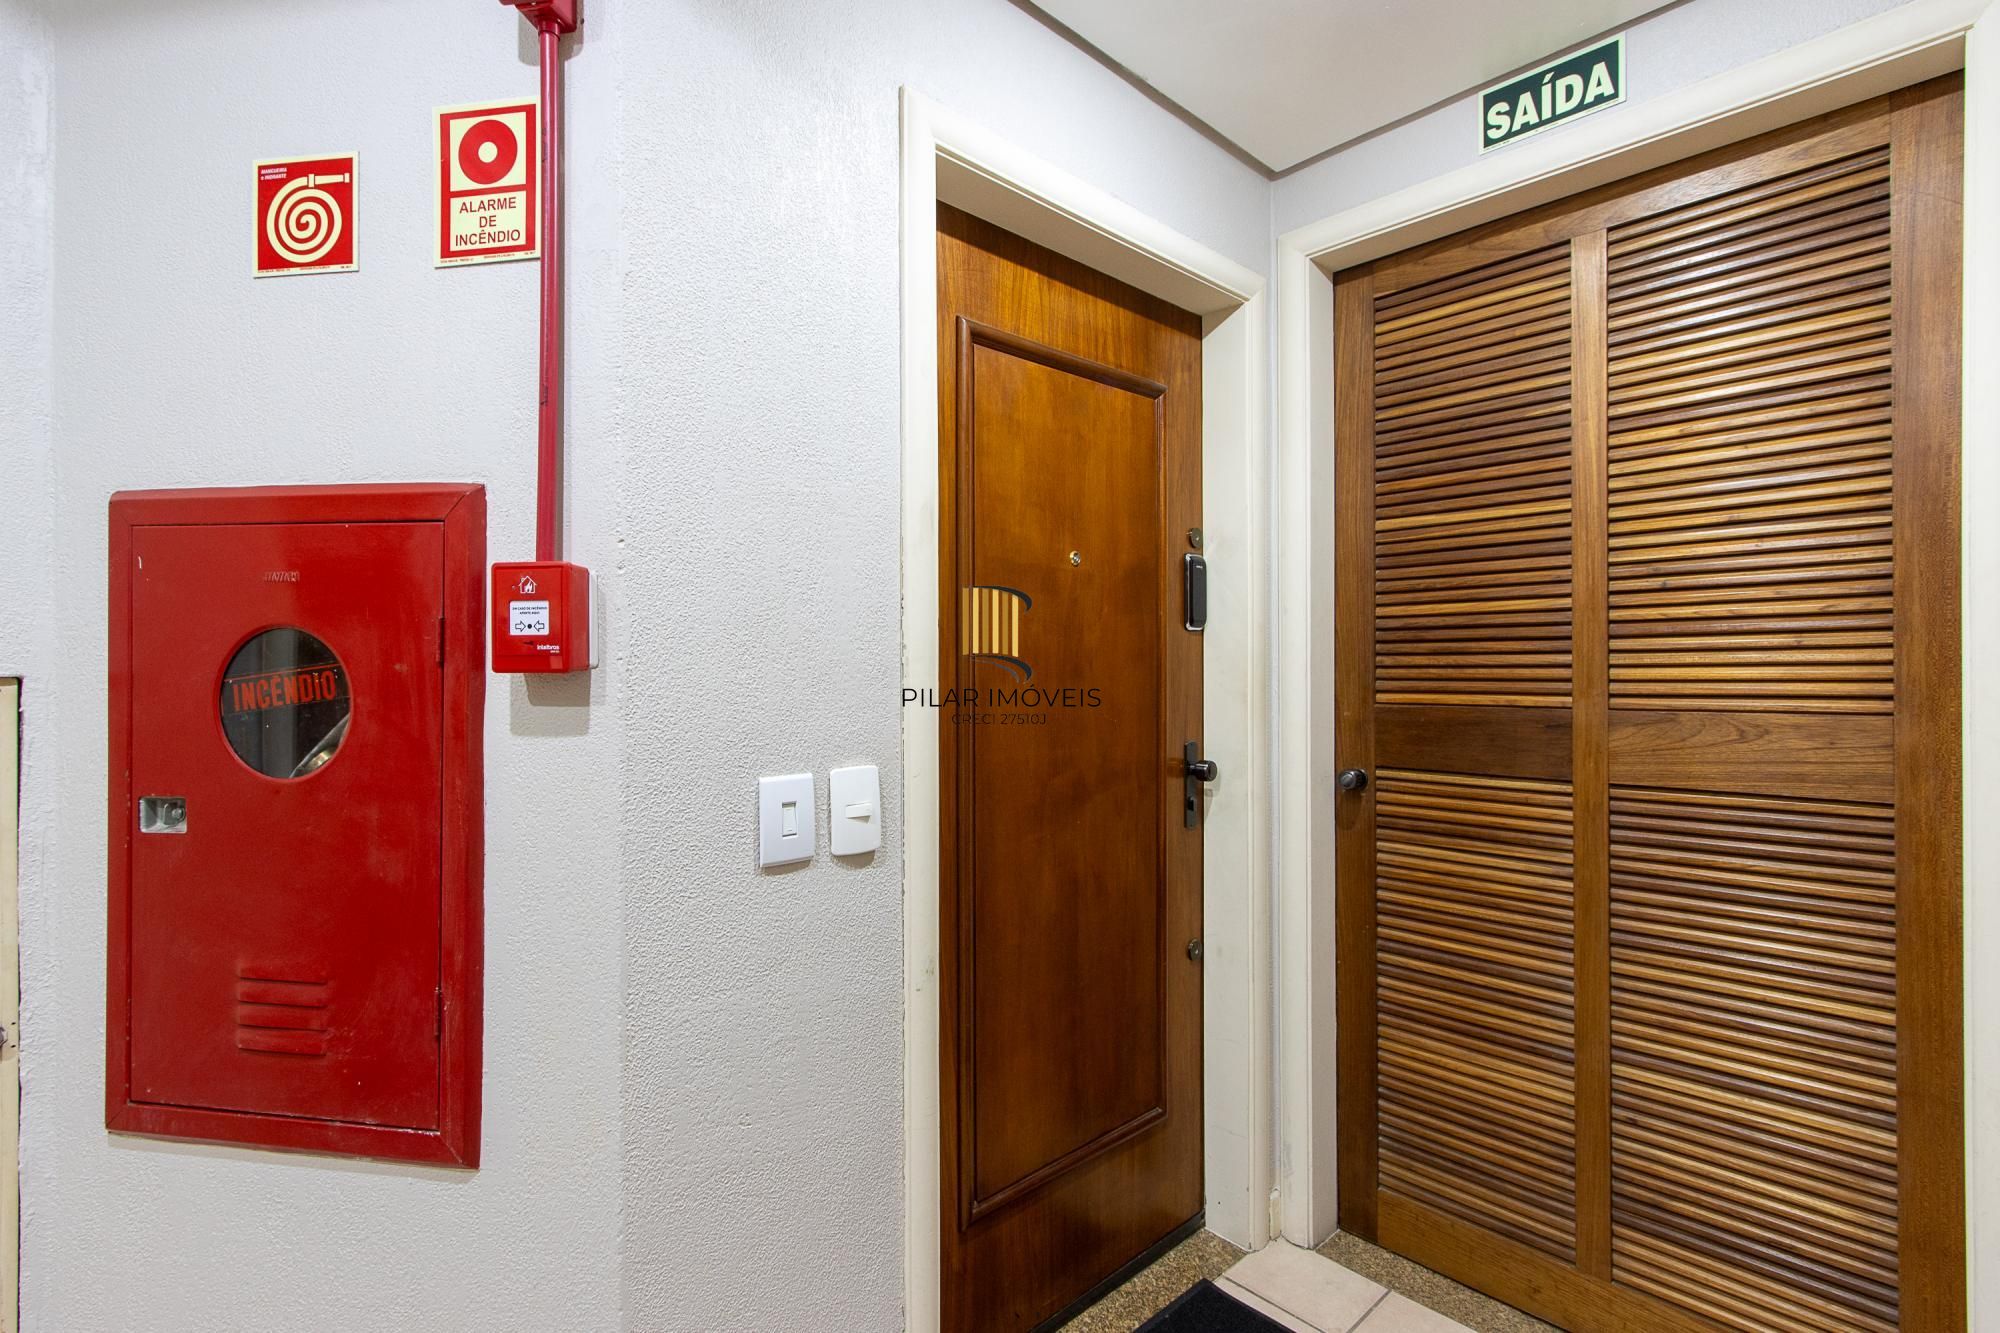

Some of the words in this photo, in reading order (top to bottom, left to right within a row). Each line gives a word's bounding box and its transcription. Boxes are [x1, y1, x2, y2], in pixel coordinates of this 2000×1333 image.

[1486, 61, 1615, 139] SAÍDA
[459, 196, 517, 214] ALARME
[479, 215, 497, 228] DE
[455, 229, 521, 247] INCÊNDIO
